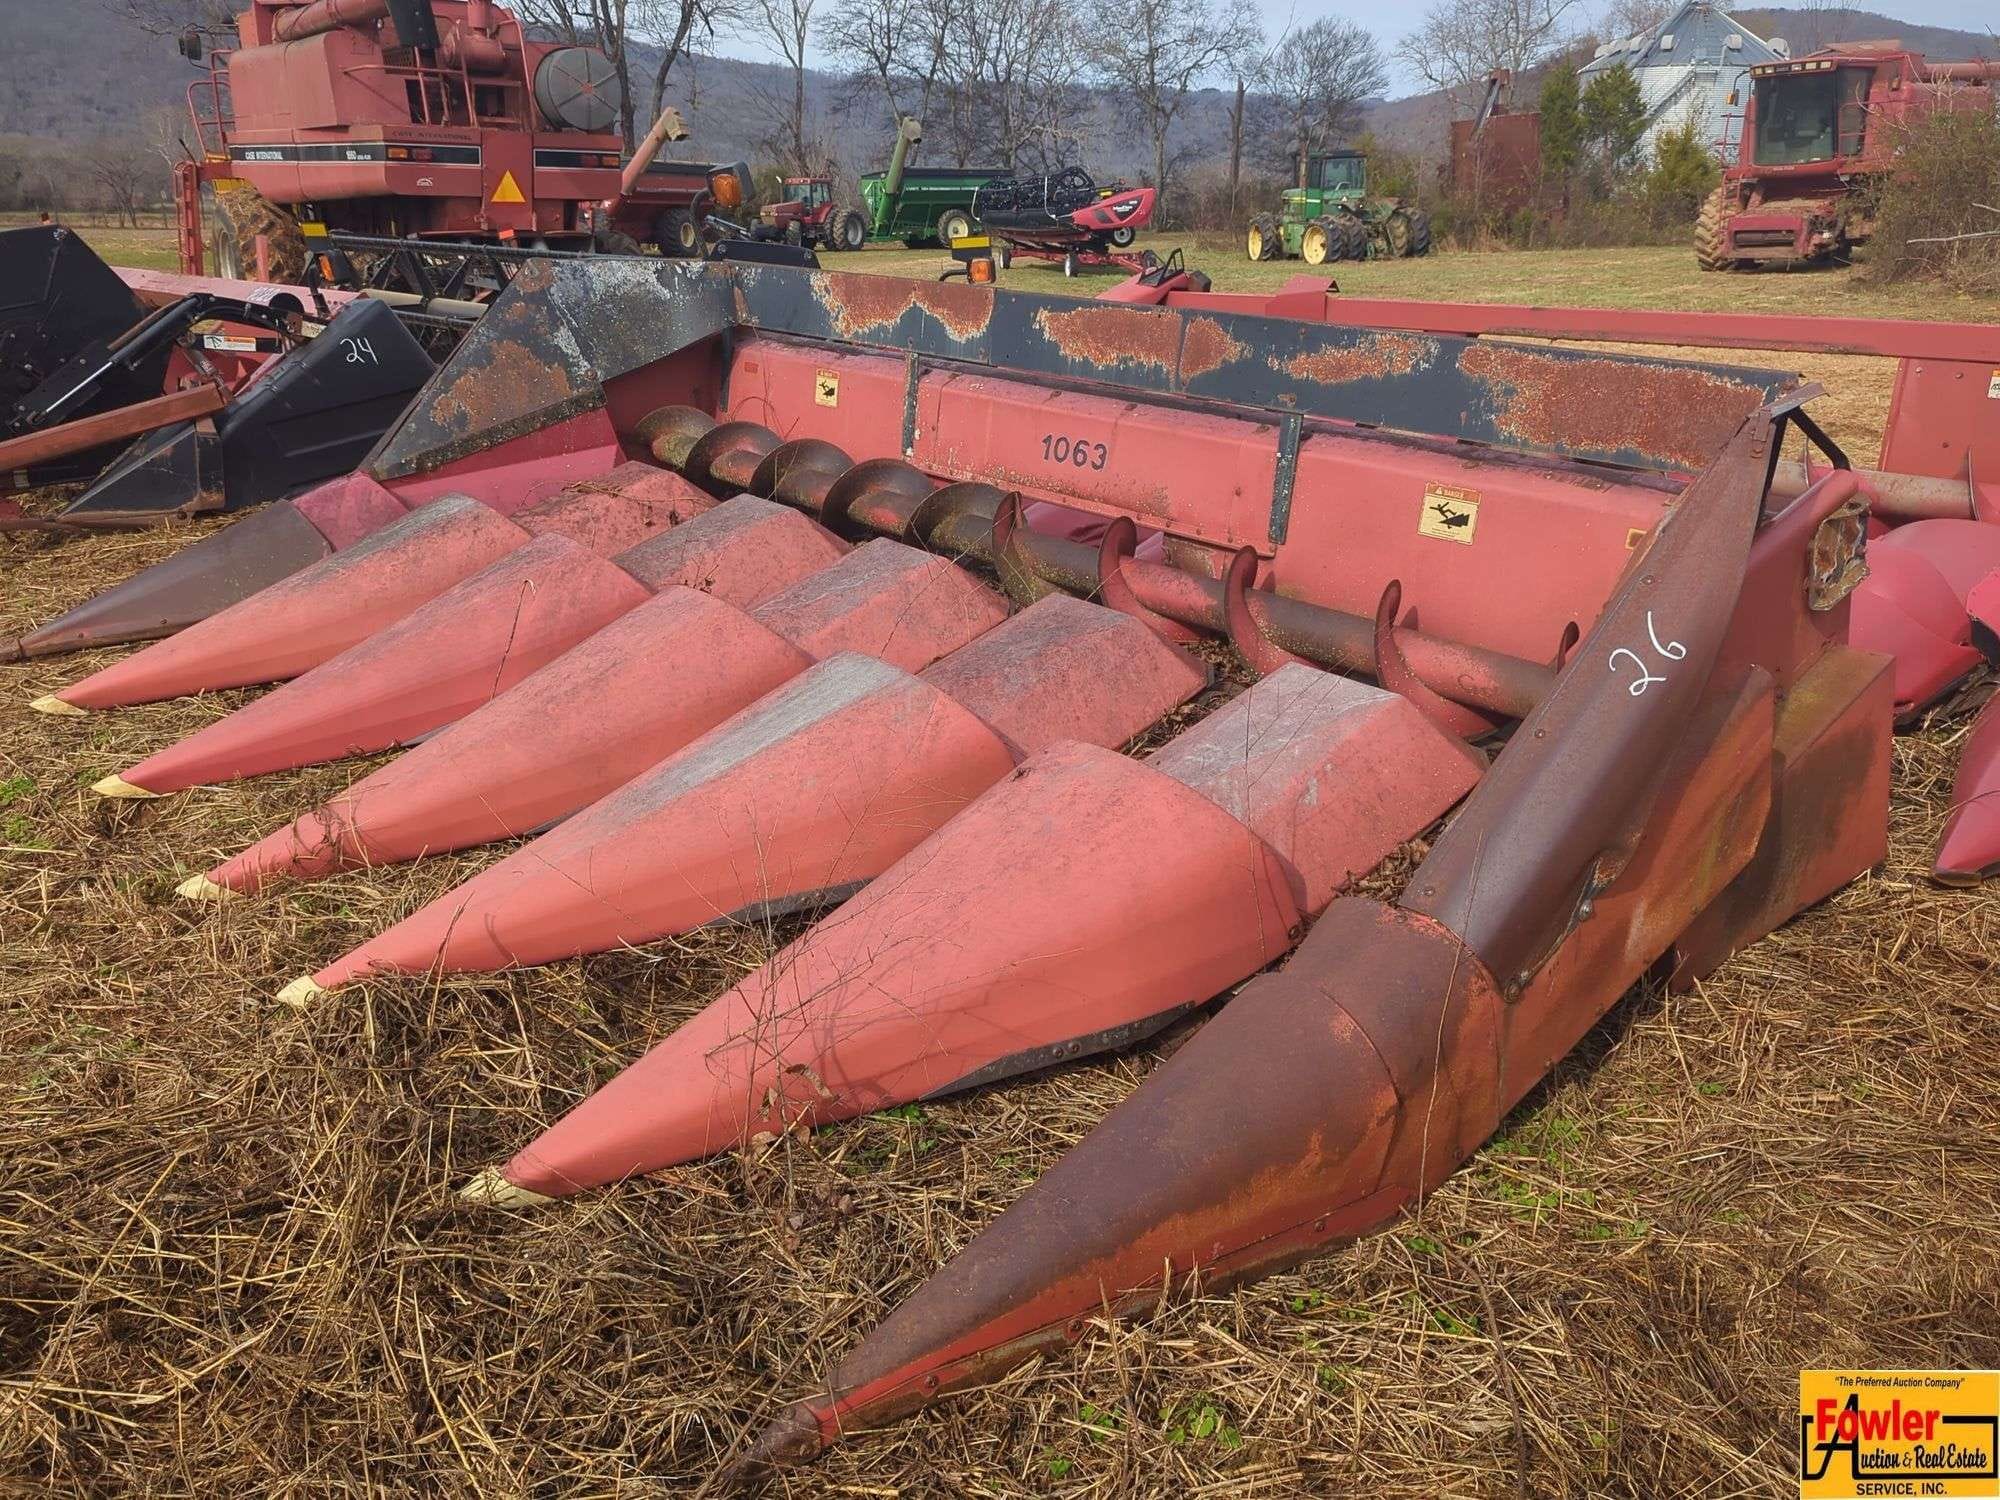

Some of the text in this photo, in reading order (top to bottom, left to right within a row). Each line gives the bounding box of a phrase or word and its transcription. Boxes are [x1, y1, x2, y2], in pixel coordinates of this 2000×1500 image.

[339, 336, 379, 366] 24
[1041, 434, 1108, 471] 1063
[1608, 610, 1687, 697] 26
